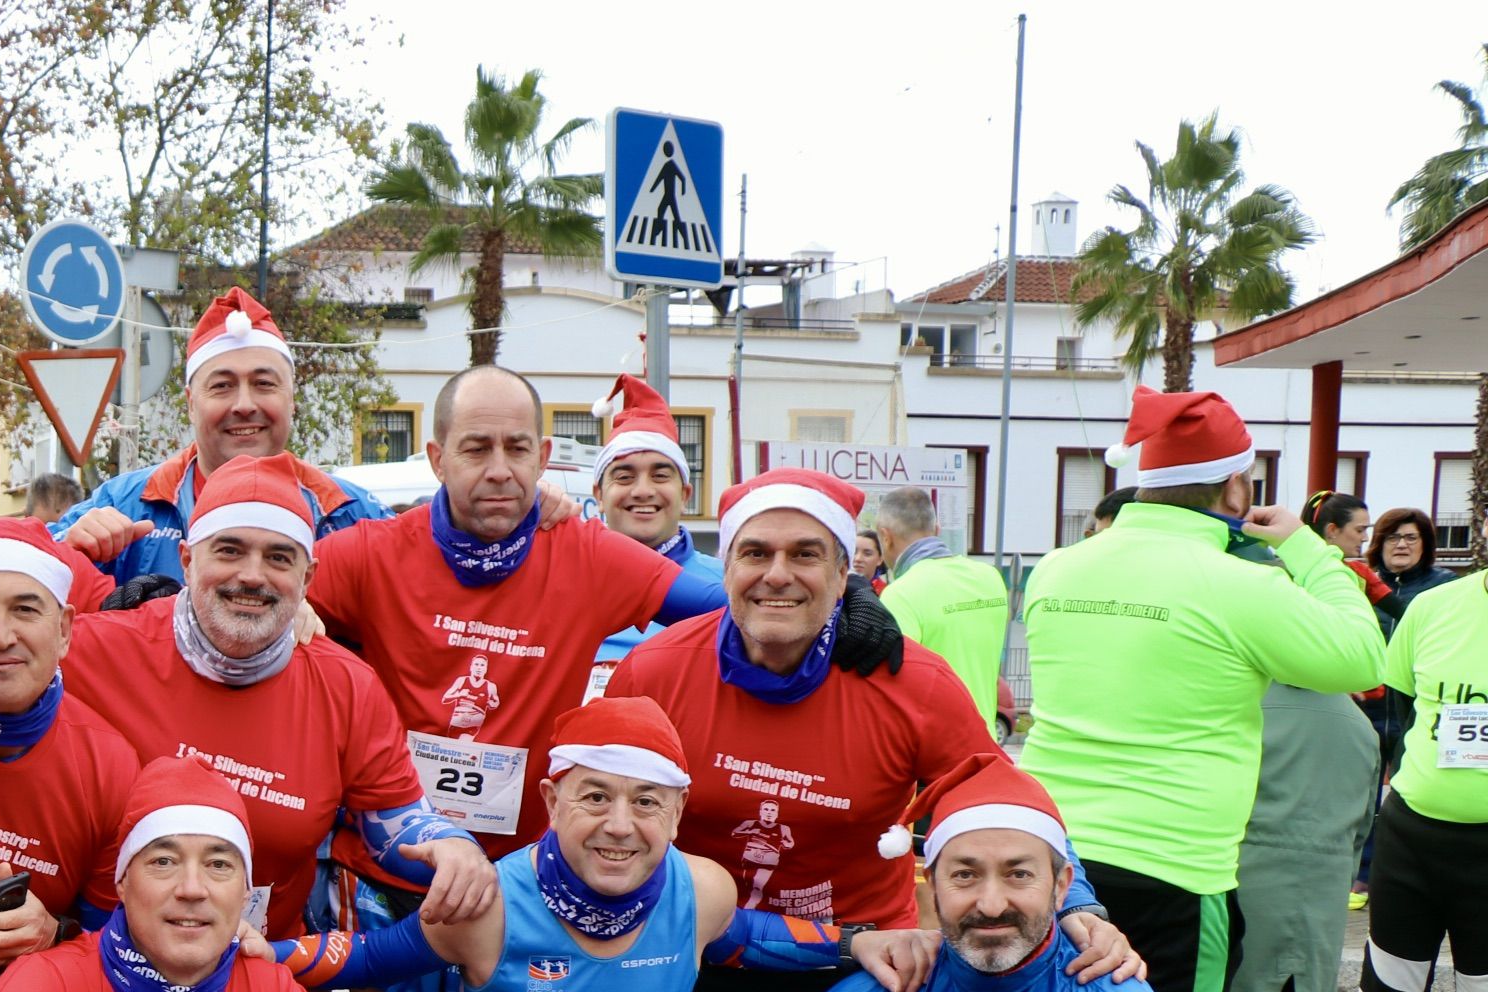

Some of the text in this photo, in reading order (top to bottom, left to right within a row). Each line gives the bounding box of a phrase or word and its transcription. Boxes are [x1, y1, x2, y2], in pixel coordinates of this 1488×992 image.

[801, 448, 909, 481] LUCENA
[433, 614, 517, 641] I San Silvestre
[448, 633, 546, 658] Ciudad de Lucena
[175, 742, 187, 758] I
[214, 754, 274, 784] Silvestre
[415, 750, 439, 761] Ciudad
[440, 755, 449, 763] de
[450, 757, 476, 767] Lucena
[417, 742, 462, 757] San Silvestre
[436, 768, 484, 796] 23
[714, 753, 813, 787] I San Silvestre
[241, 781, 305, 811] de Lucena
[730, 773, 851, 810] Ciudad de Lucena
[473, 812, 506, 821] enerplus
[12, 850, 59, 877] Lucena
[780, 880, 833, 898] MEMORIAL
[785, 897, 832, 916] HURTADO
